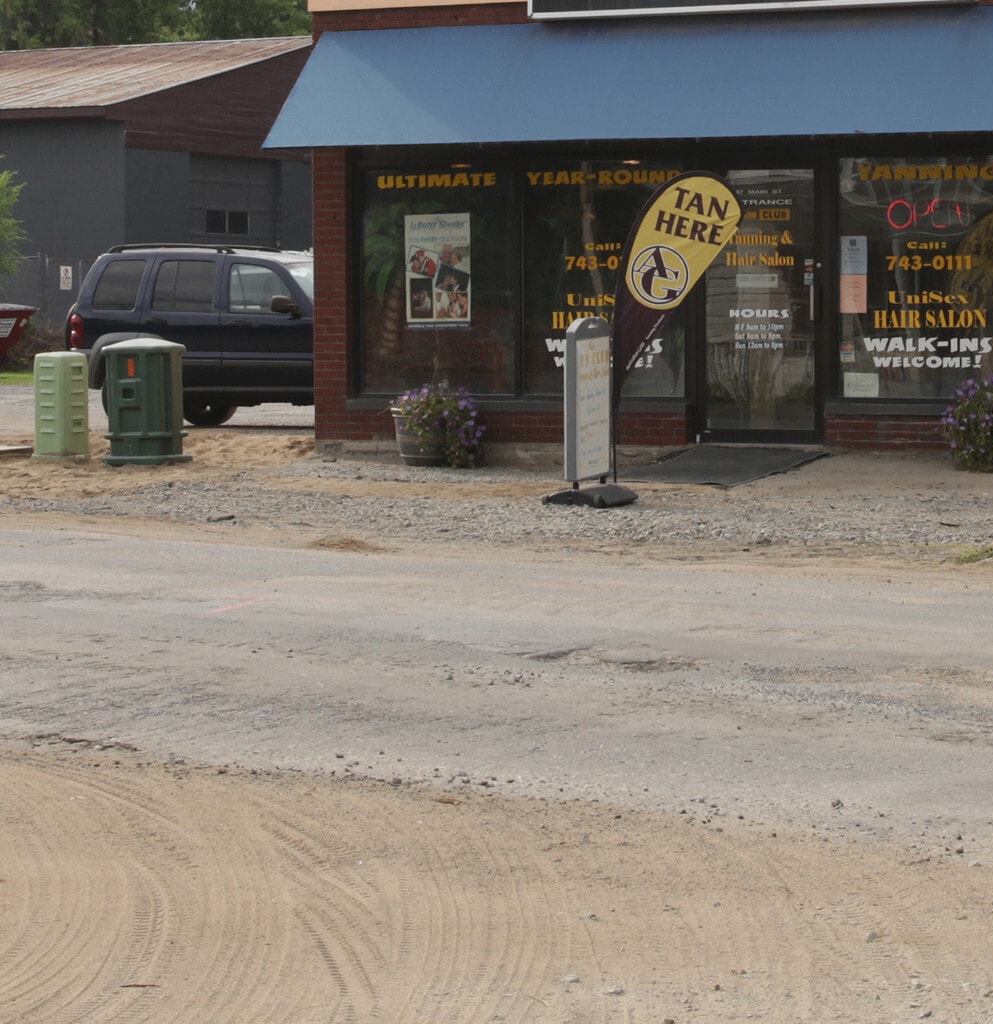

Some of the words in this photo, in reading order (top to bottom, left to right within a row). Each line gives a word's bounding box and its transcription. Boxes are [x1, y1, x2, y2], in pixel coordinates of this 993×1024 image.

[378, 173, 497, 190] ULTIMATE
[675, 187, 729, 221] TAN
[762, 210, 788, 219] CLUB
[886, 198, 970, 229] OPEN
[656, 210, 724, 246] HERE
[781, 229, 793, 245] &
[906, 240, 947, 250] Call:
[585, 242, 622, 251] Call:
[565, 255, 622, 270] 743-0
[725, 251, 756, 266] Hair
[759, 251, 795, 267] Salon
[885, 255, 972, 271] 743-0111
[566, 293, 616, 307] UniS
[729, 309, 790, 319] HOURS
[873, 309, 921, 328] HAIR
[925, 309, 987, 328] SALON
[863, 337, 993, 353] WALK-INS
[872, 355, 982, 369] WELCOME!
